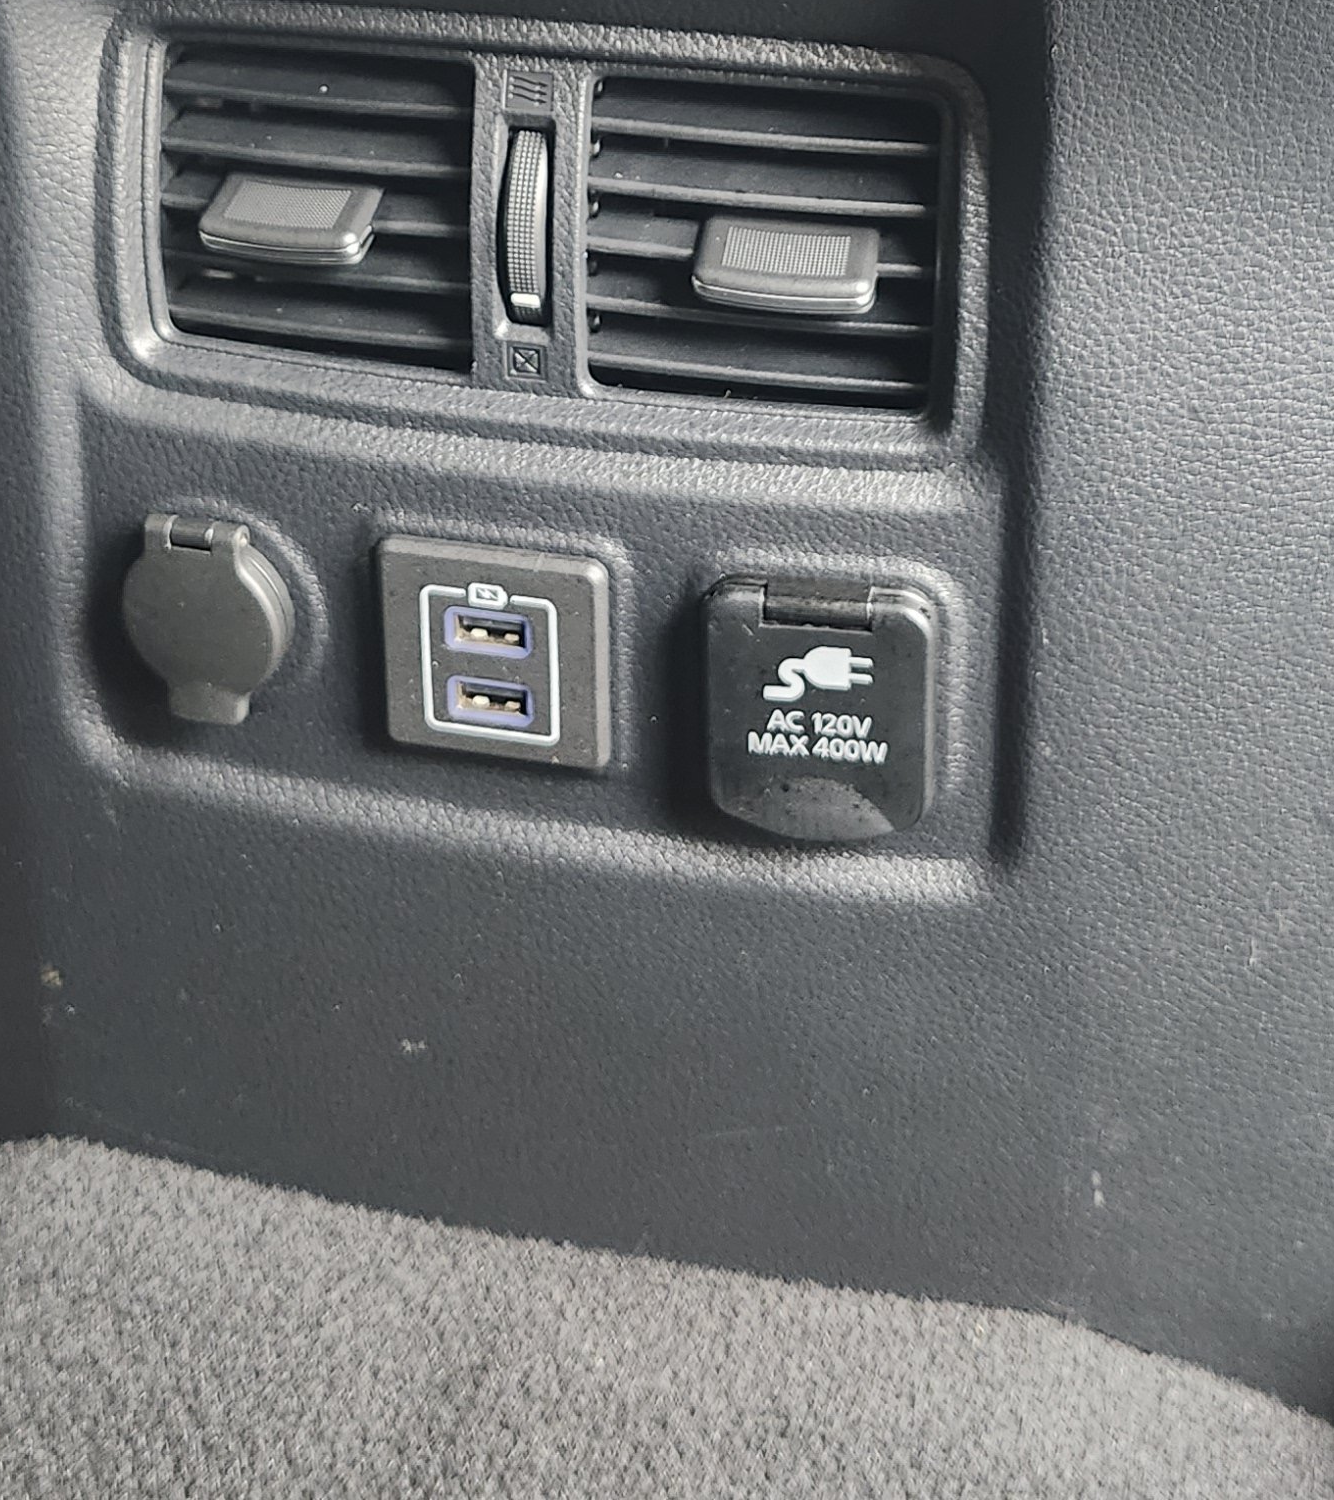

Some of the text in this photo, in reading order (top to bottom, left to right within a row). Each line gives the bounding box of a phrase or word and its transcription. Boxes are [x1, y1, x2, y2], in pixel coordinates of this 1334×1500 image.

[766, 708, 873, 739] AC 120V
[747, 730, 888, 764] MAX 400W
